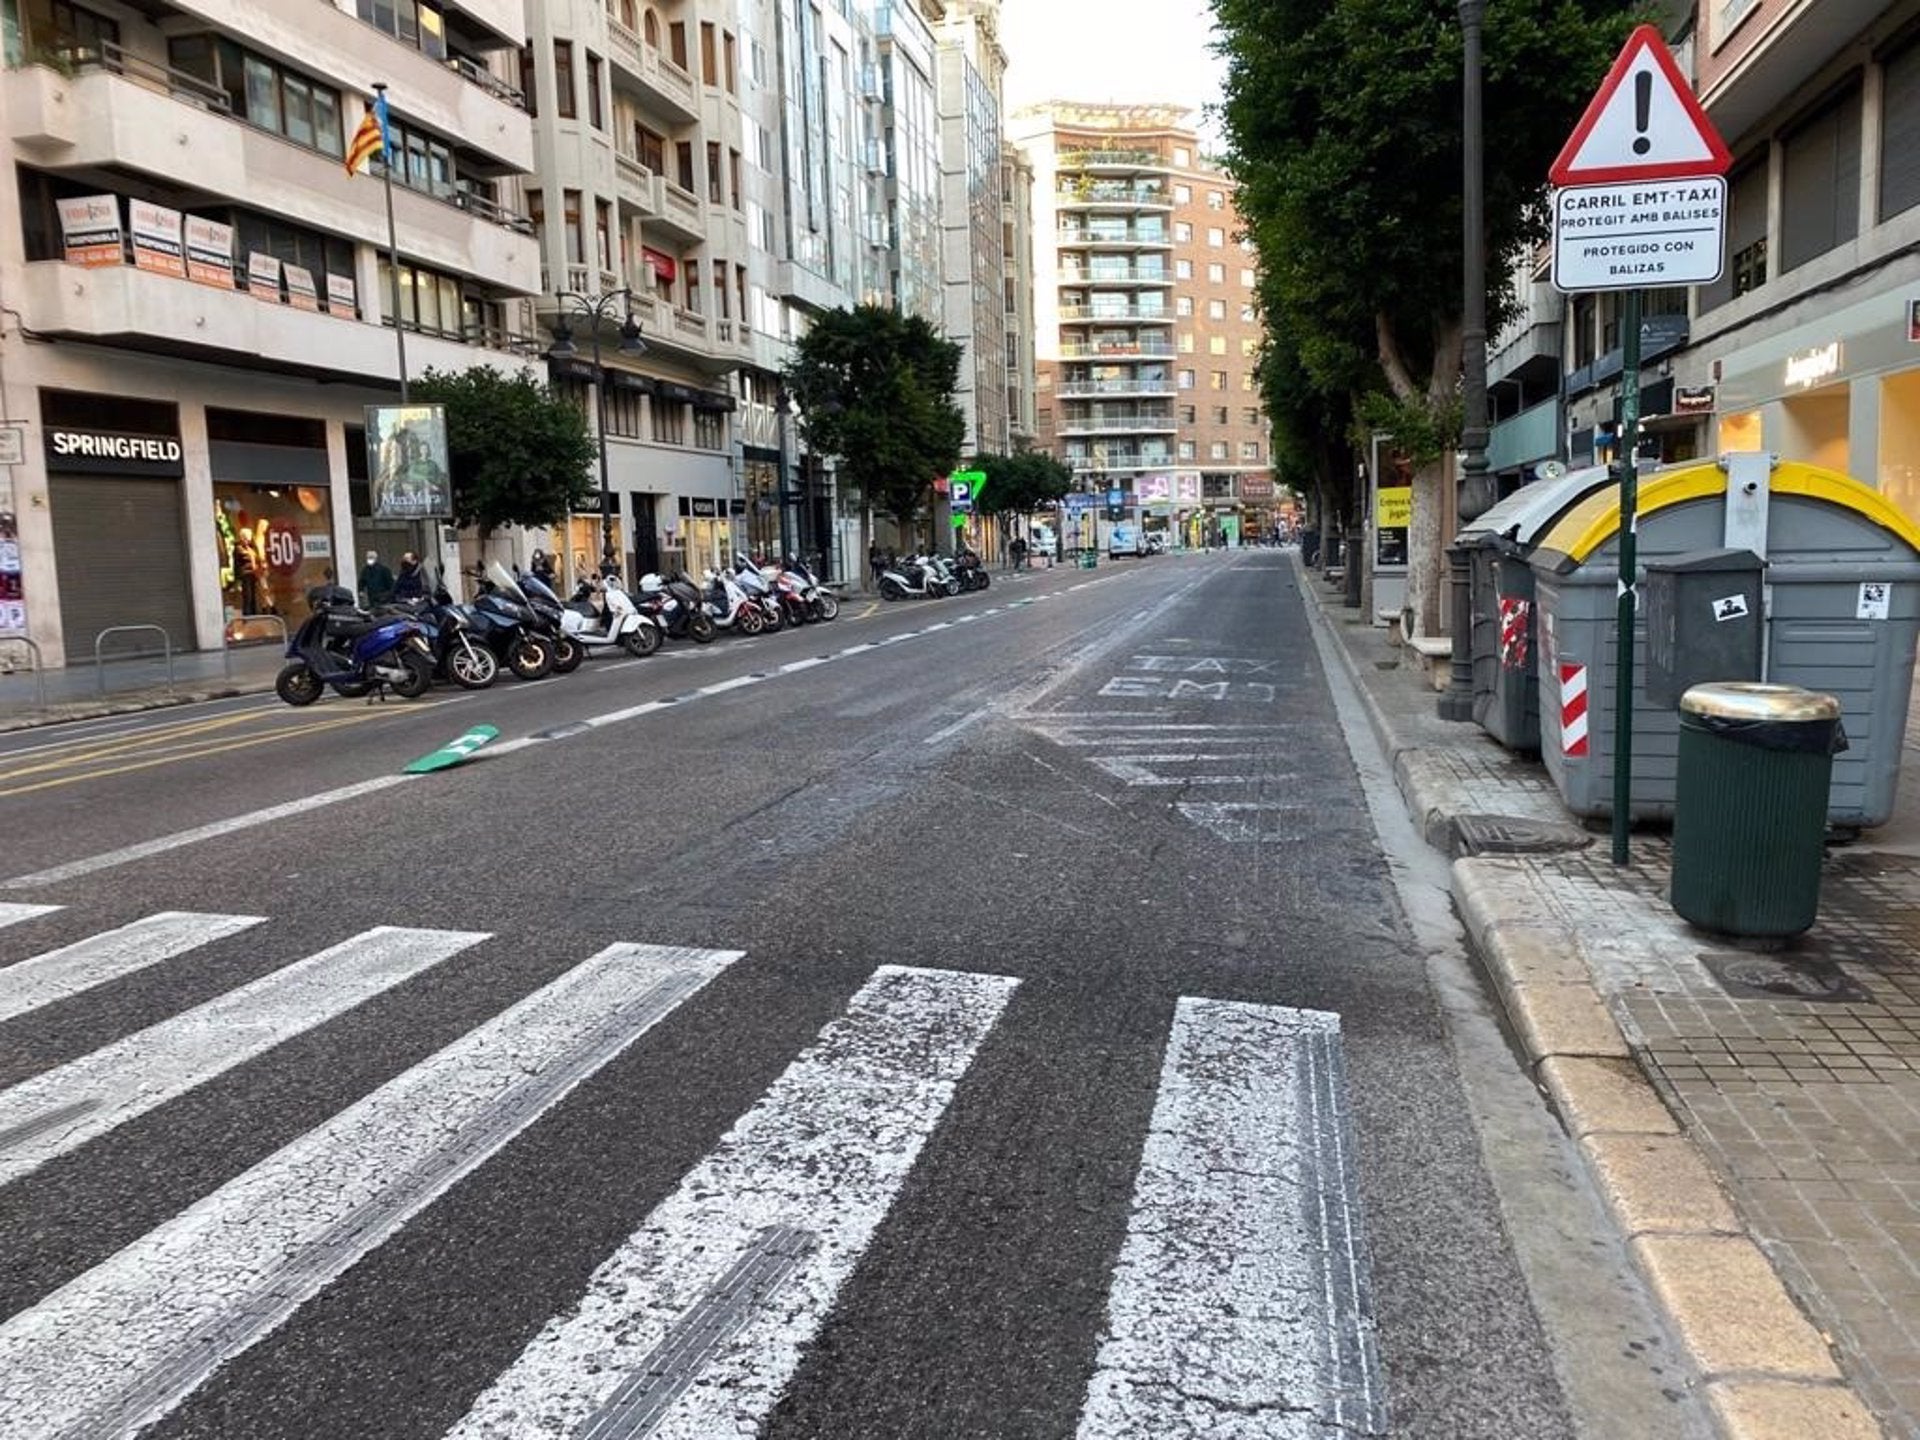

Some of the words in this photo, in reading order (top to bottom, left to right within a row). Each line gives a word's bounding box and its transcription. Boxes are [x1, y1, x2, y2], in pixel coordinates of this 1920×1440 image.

[1564, 194, 1627, 211] CARRIL
[1633, 187, 1718, 206] EMT-TAXI
[1560, 214, 1626, 229] PROTEGIT
[1630, 212, 1659, 224] AMB
[1662, 207, 1720, 221] BALISES
[1583, 242, 1660, 258] PROTEGIDO
[1664, 241, 1695, 252] CON
[1609, 262, 1666, 276] BALIZAS
[53, 432, 181, 461] SPRINGFIELD
[952, 483, 969, 500] P
